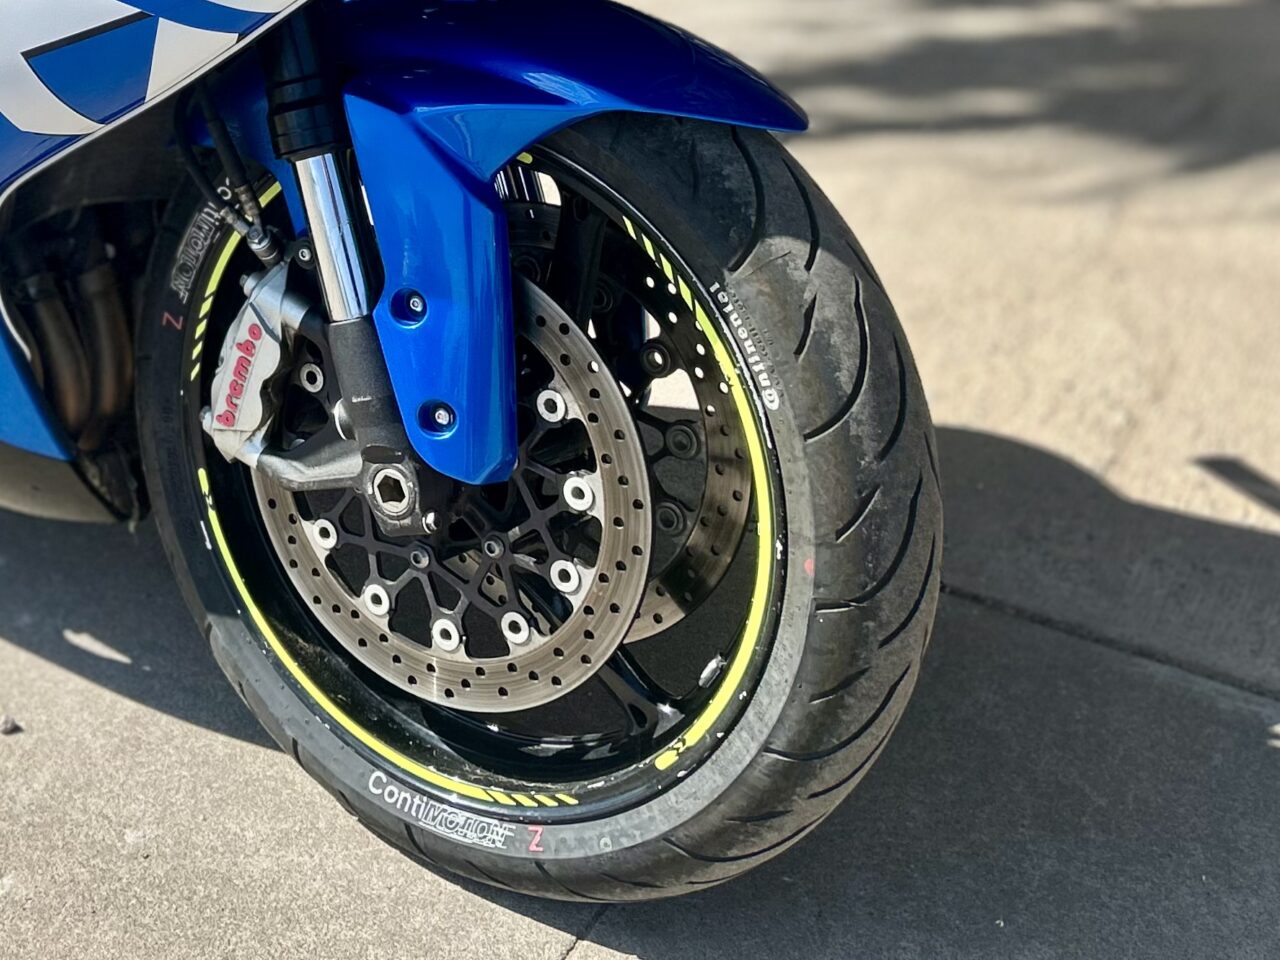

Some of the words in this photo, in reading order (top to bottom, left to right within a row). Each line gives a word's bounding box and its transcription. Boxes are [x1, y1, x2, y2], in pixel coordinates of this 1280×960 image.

[162, 311, 184, 331] Z
[708, 280, 780, 411] Continental
[215, 322, 263, 428] brembo
[527, 825, 545, 853] Z
